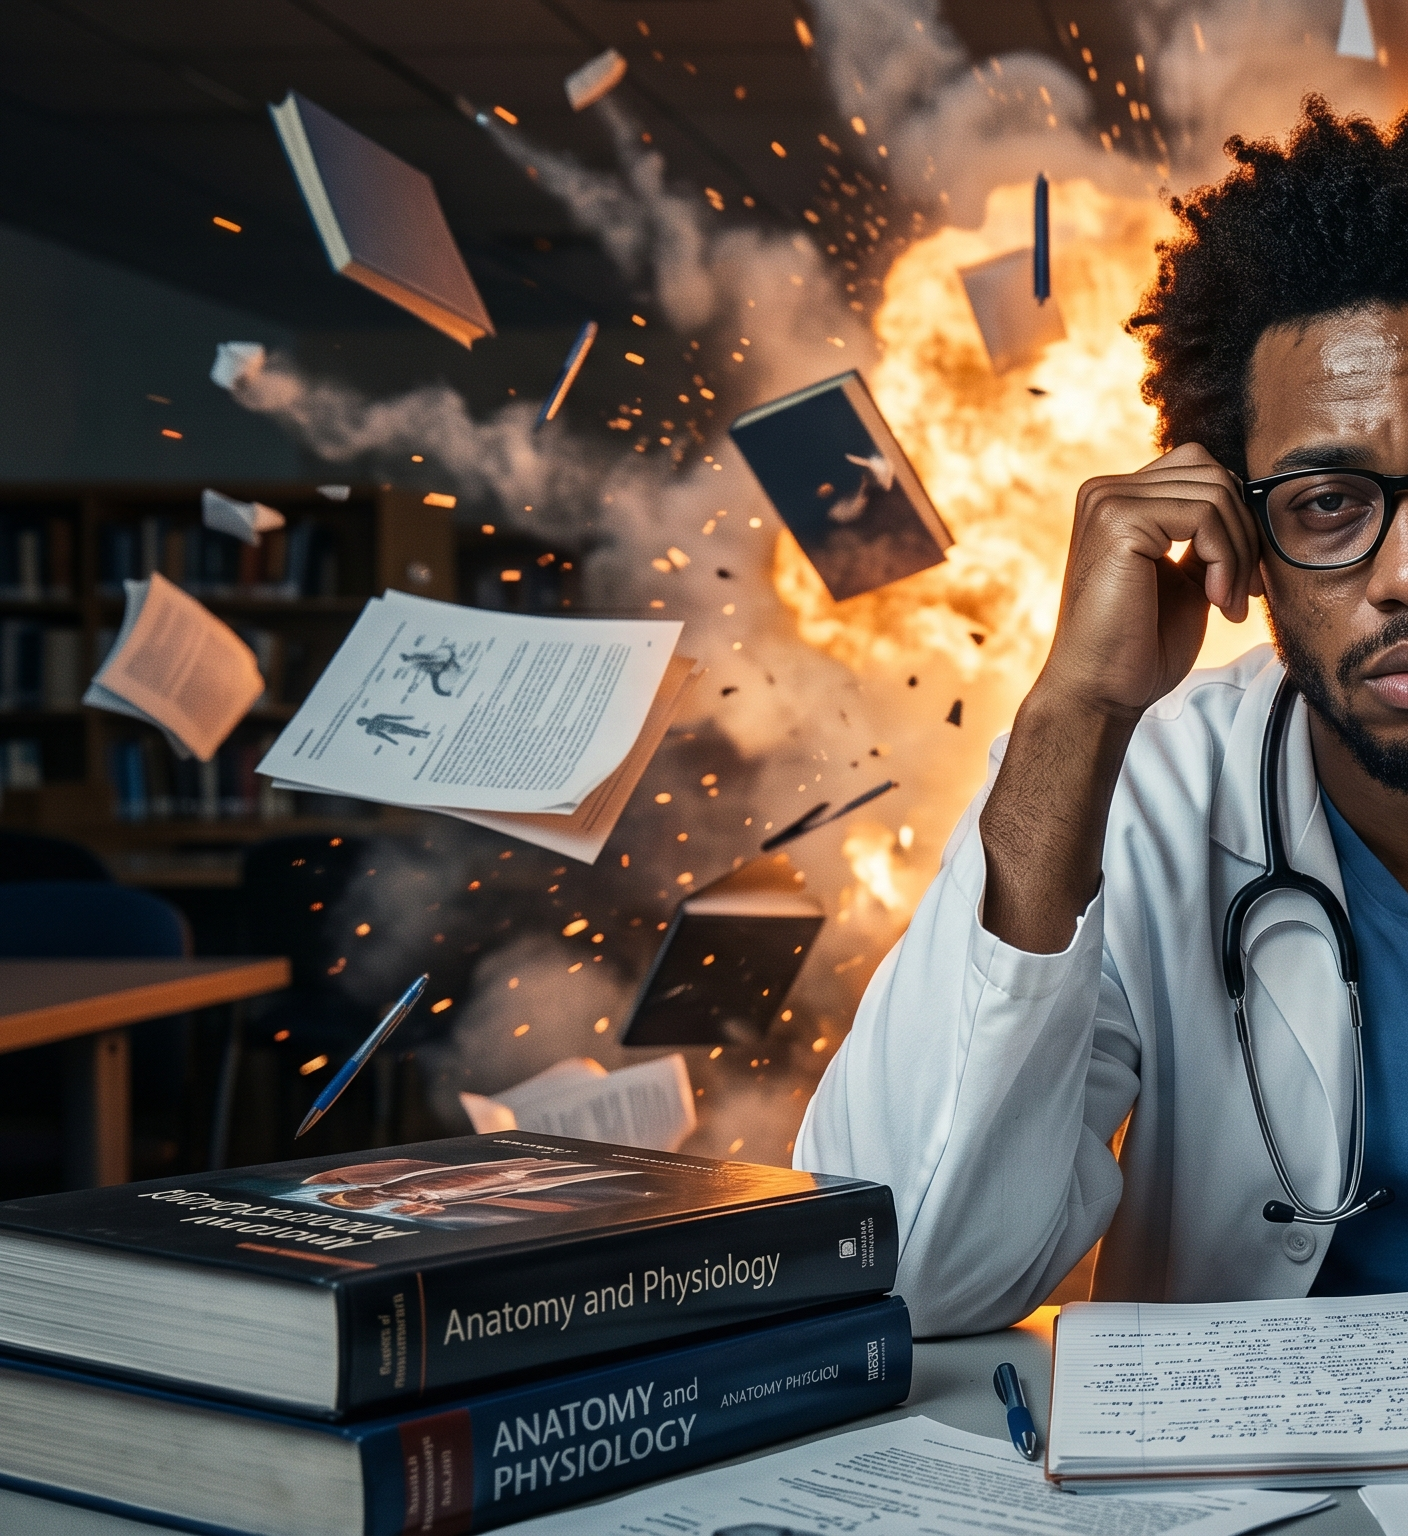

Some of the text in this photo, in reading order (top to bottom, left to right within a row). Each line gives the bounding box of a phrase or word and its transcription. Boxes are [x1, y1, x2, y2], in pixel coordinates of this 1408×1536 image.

[443, 1294, 576, 1346] Anatomy
[583, 1272, 634, 1317] and
[643, 1252, 781, 1306] Physiology
[492, 1377, 698, 1458] ANATOMY and
[720, 1379, 783, 1408] ANATOMY
[493, 1413, 698, 1502] PHYSIOLOGY
